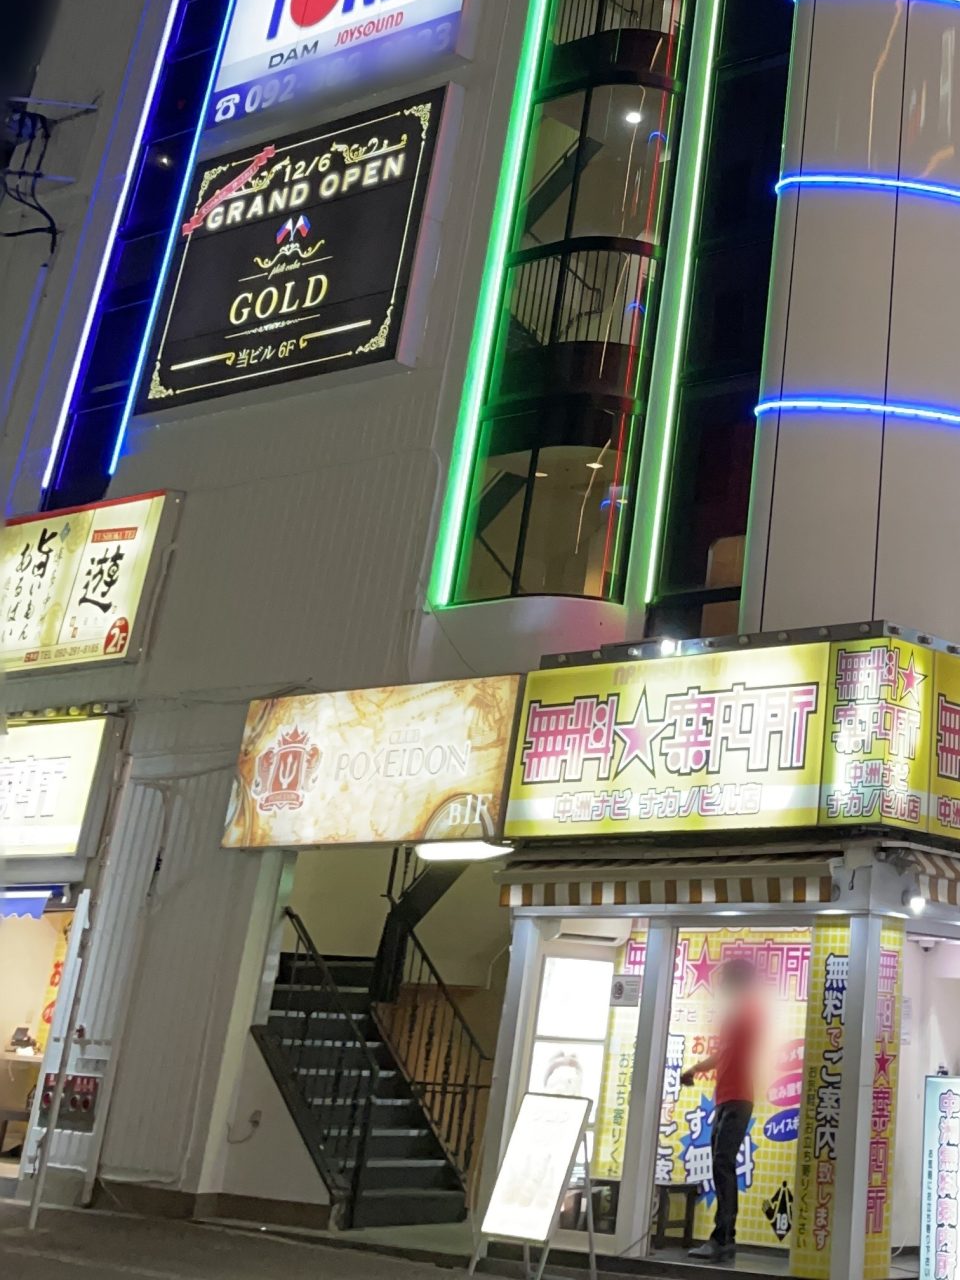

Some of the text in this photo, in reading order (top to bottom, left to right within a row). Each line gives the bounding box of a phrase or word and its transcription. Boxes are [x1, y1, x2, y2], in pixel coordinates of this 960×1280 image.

[267, 40, 319, 70] DAM
[334, 11, 404, 47] JOYSOUND
[284, 153, 332, 182] 12/6
[206, 181, 310, 232] GRAND
[318, 153, 405, 200] OPEN
[229, 274, 328, 325] GOLD
[105, 628, 127, 654] 2F
[335, 739, 472, 782] POSEIDON
